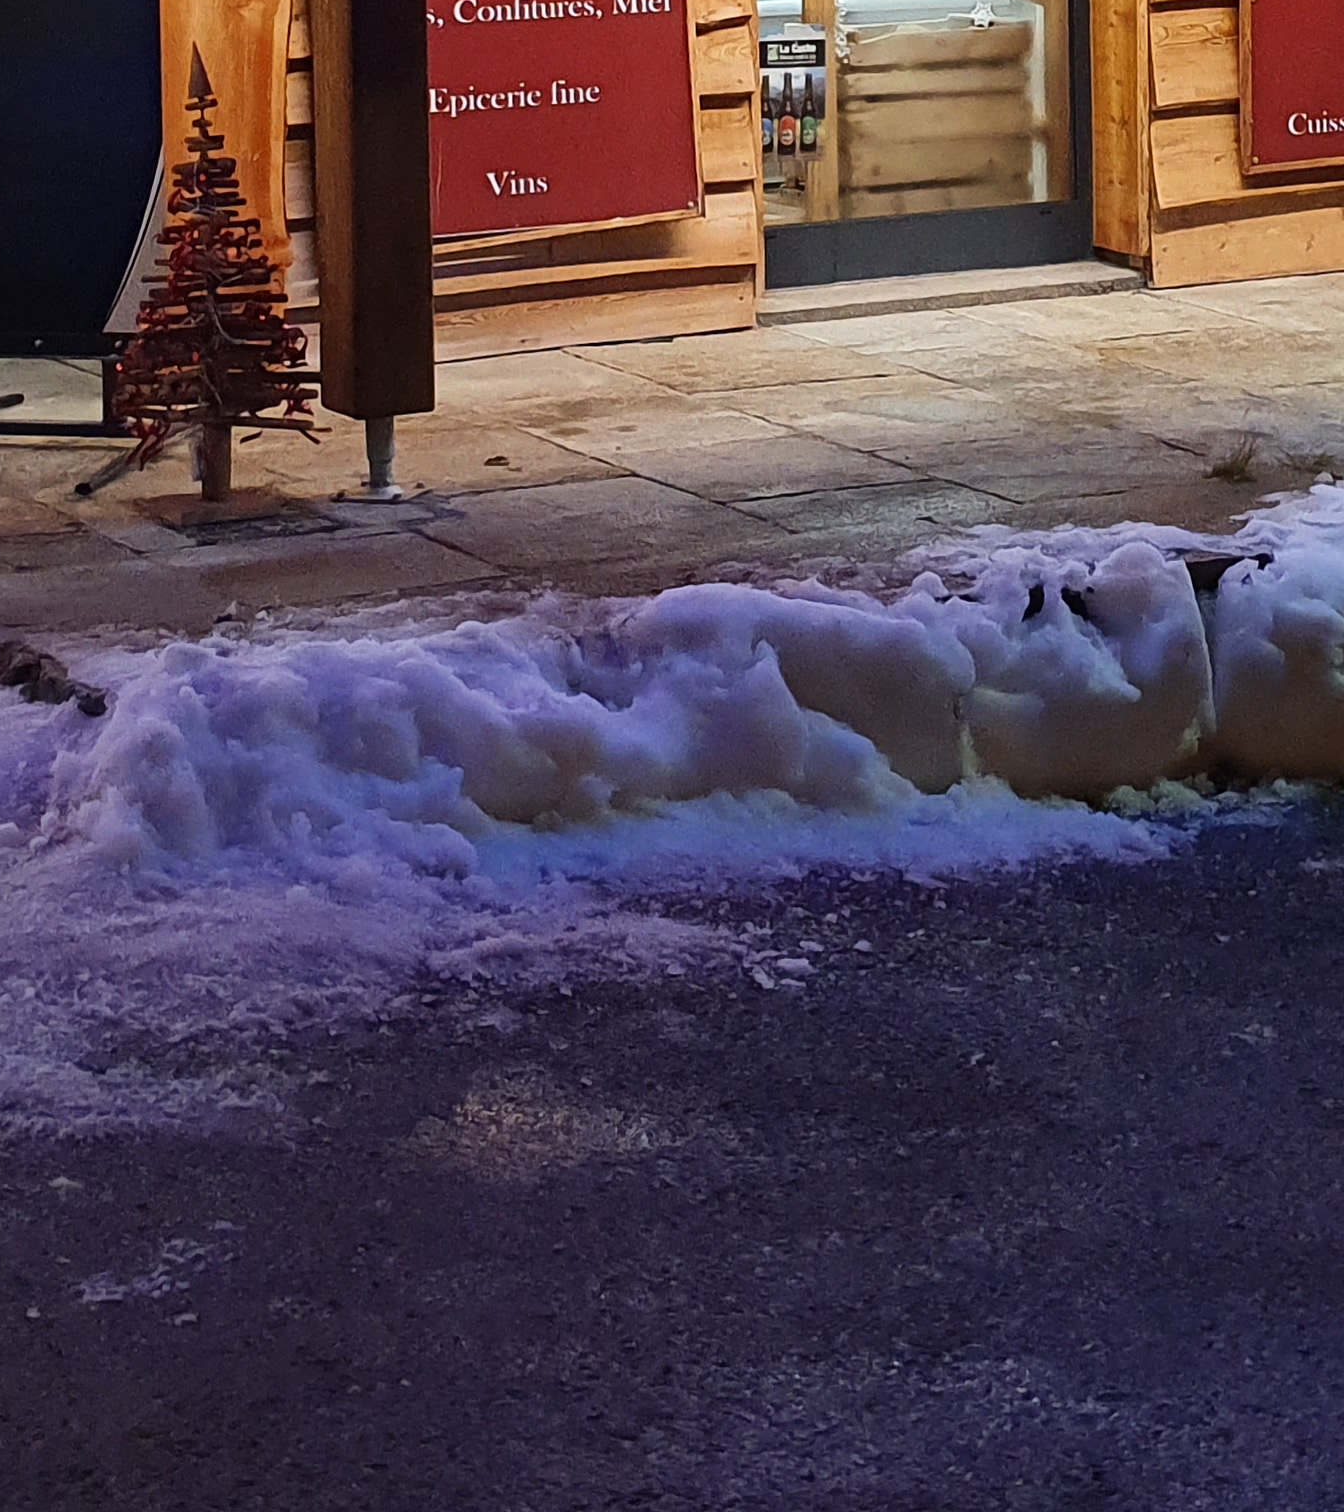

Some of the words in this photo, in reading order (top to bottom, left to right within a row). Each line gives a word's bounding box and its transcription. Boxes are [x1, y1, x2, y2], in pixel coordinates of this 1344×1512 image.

[429, 82, 542, 117] Epicerie
[551, 79, 601, 106] fine
[485, 170, 549, 197] Vins
